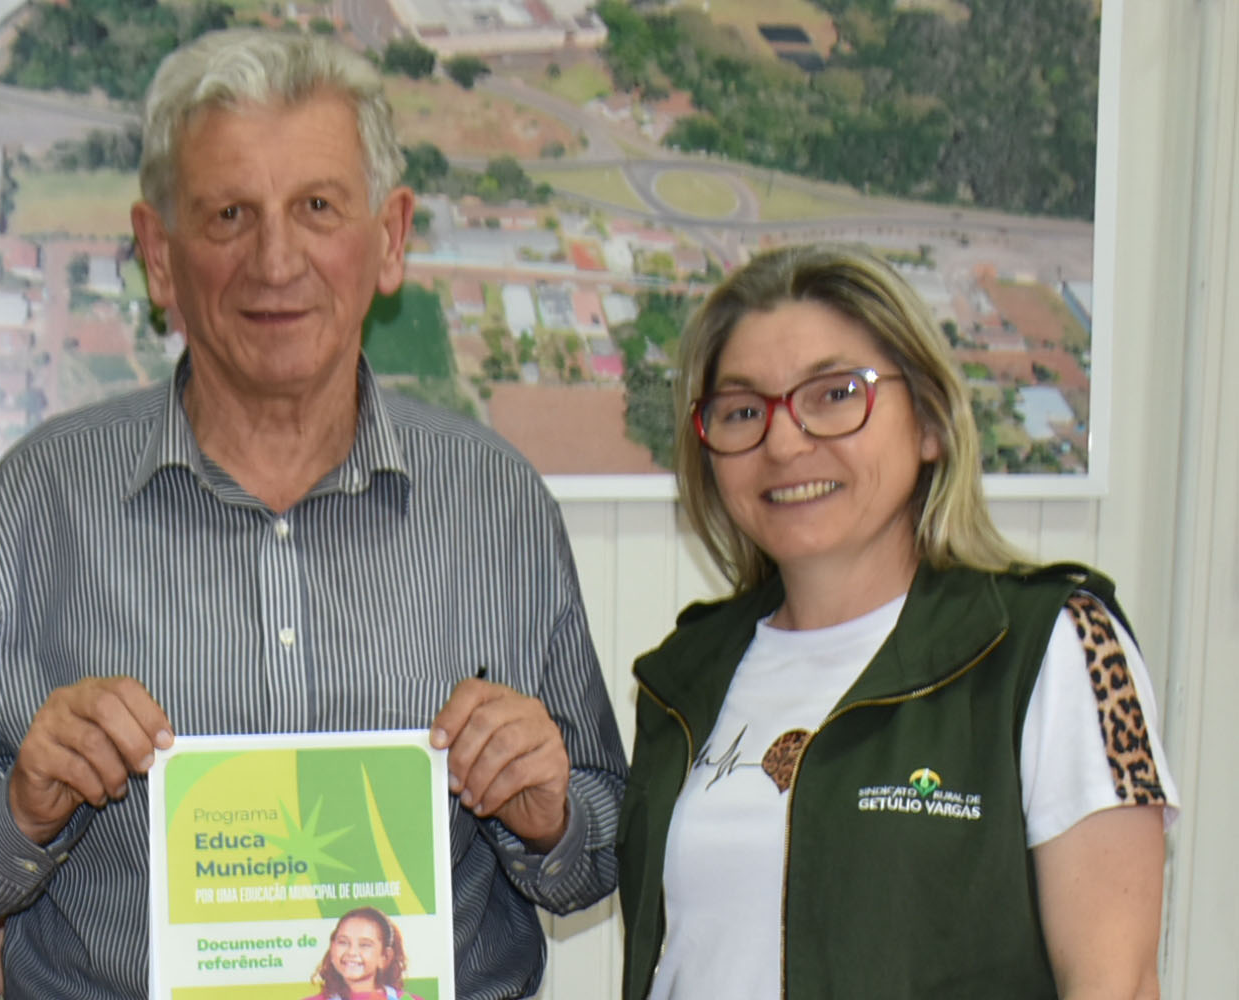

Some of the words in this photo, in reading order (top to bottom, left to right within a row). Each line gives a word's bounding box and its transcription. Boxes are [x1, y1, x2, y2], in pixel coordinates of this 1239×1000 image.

[858, 785, 917, 798] SINDICATO
[932, 789, 964, 803] RURAL
[966, 794, 981, 805] DE
[193, 807, 278, 825] Programa
[858, 796, 922, 813] GETÚLIO
[925, 799, 981, 819] VARGAS
[195, 831, 266, 850] Educa
[196, 855, 309, 879] Município
[195, 887, 214, 904] POR
[216, 886, 239, 903] UMA
[240, 882, 287, 902] EDUCAÇÃO
[289, 882, 337, 900] MUNICIPAL
[339, 882, 351, 899] DE
[353, 880, 401, 899] QUALIDADE
[197, 936, 293, 952] Documento
[297, 933, 318, 948] de
[197, 954, 283, 971] referência
